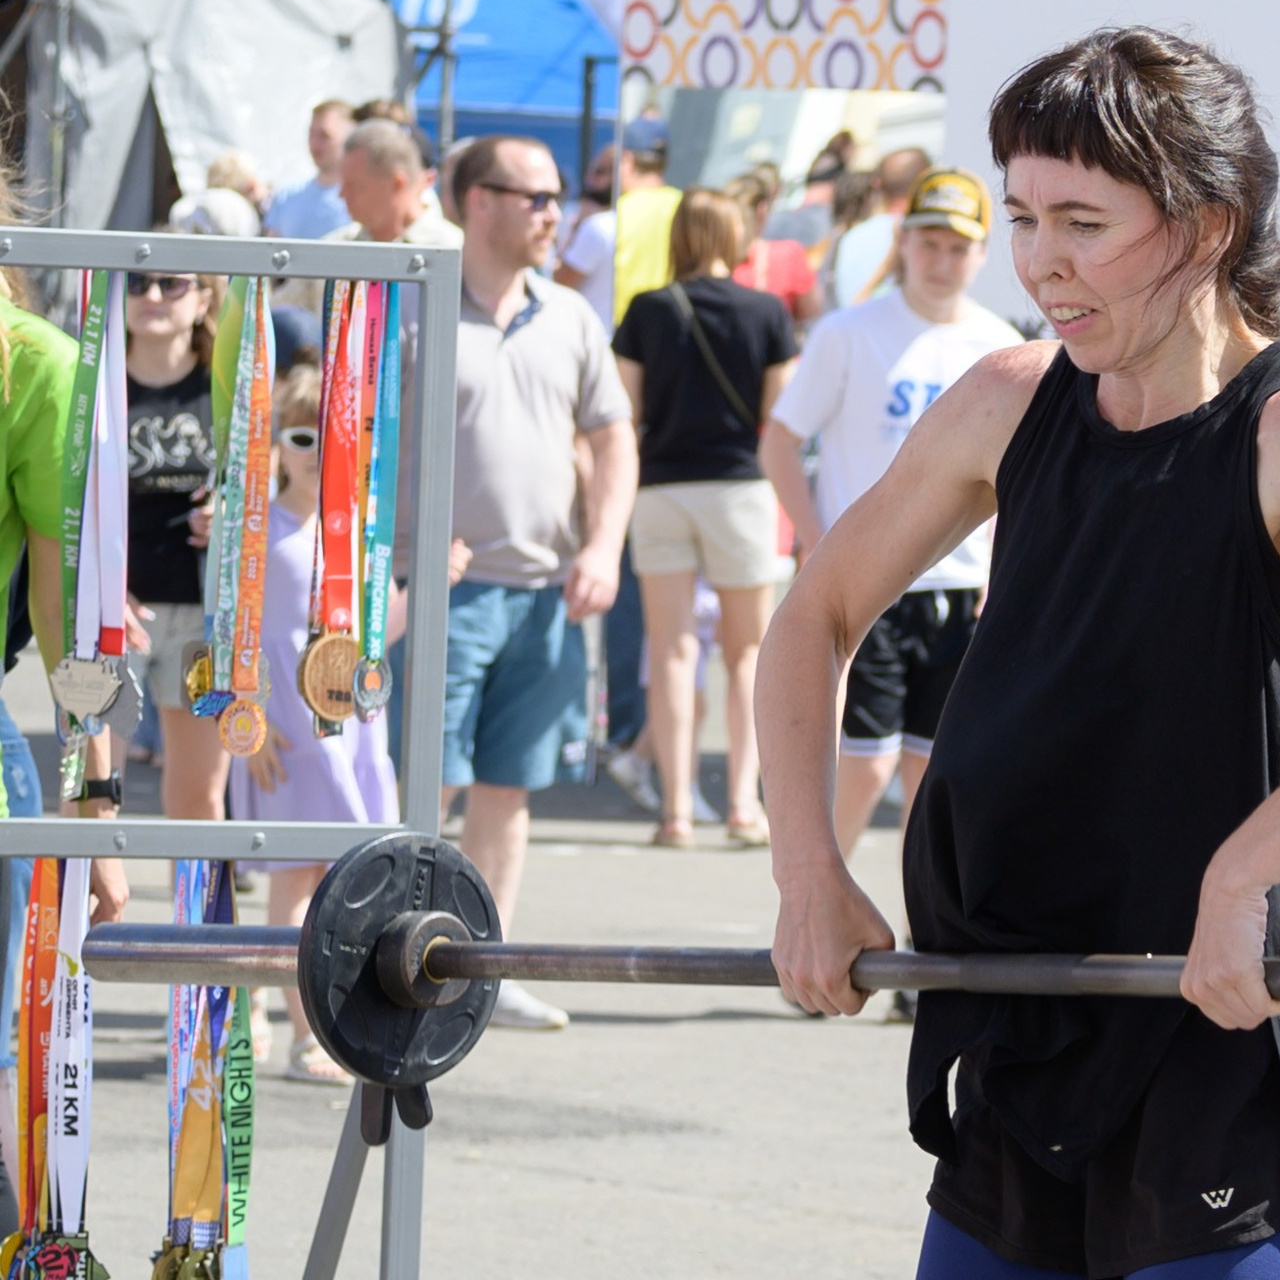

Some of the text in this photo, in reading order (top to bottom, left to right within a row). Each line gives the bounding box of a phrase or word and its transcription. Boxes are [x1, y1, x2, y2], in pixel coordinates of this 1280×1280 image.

[86, 304, 102, 338] 21,1
[370, 543, 391, 632] Вятские
[71, 978, 79, 1011] ОГНИ
[64, 1064, 79, 1136] 21 КМ
[230, 1037, 252, 1128] NIGHTS
[231, 1134, 248, 1227] WHITE
[41, 1246, 77, 1272] 21
